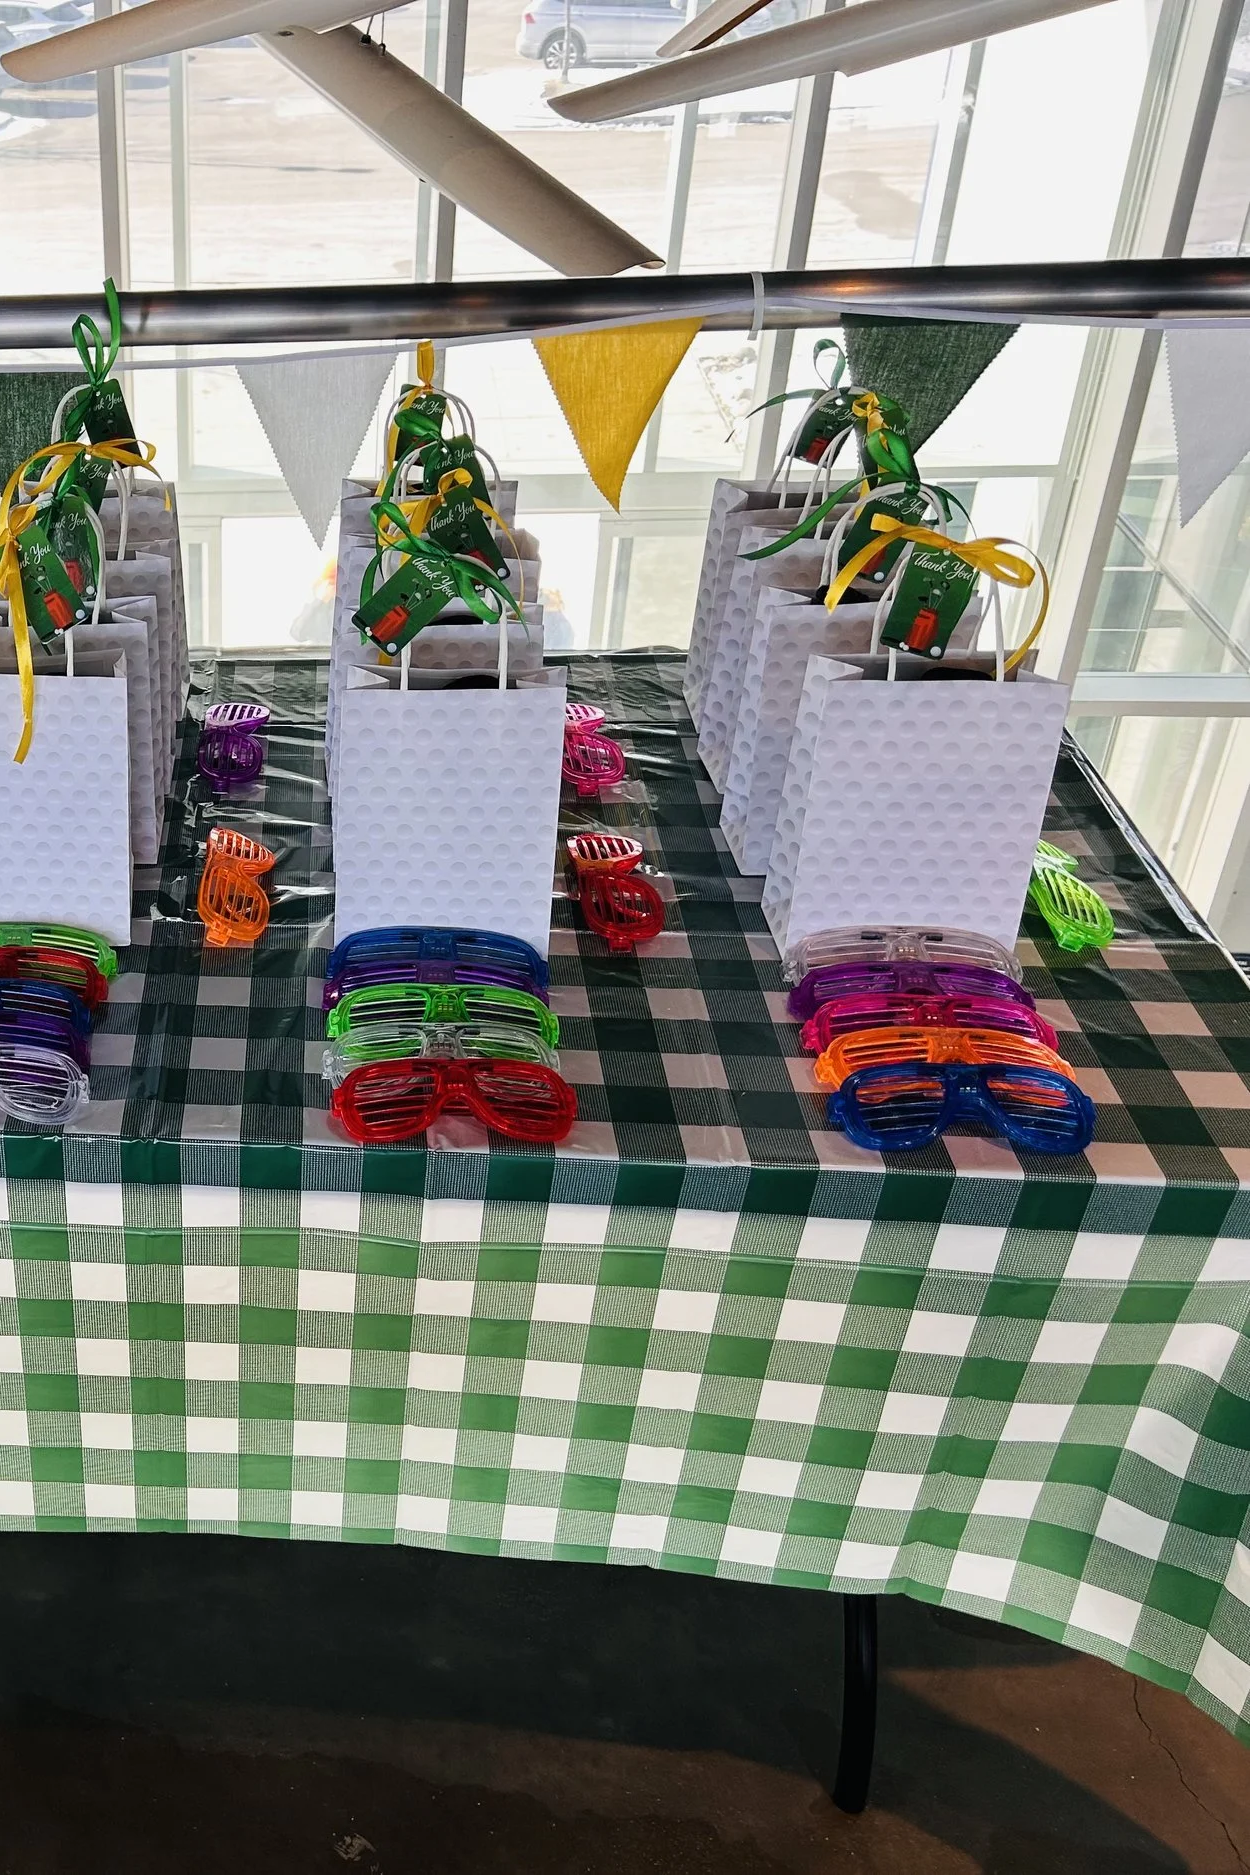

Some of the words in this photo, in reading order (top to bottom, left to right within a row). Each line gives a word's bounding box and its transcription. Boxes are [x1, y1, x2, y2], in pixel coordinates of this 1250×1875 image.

[105, 392, 123, 410] You
[411, 401, 426, 411] ank
[427, 401, 445, 415] You
[838, 408, 859, 422] You
[434, 453, 453, 470] ank
[454, 447, 474, 464] You
[89, 463, 108, 479] You
[430, 509, 455, 532] Thank
[454, 501, 476, 522] You
[901, 498, 925, 516] You
[68, 511, 88, 531] You
[30, 543, 52, 565] You
[912, 551, 950, 573] Thank
[945, 561, 974, 581] You
[411, 556, 443, 581] Thank
[431, 575, 457, 598] You
